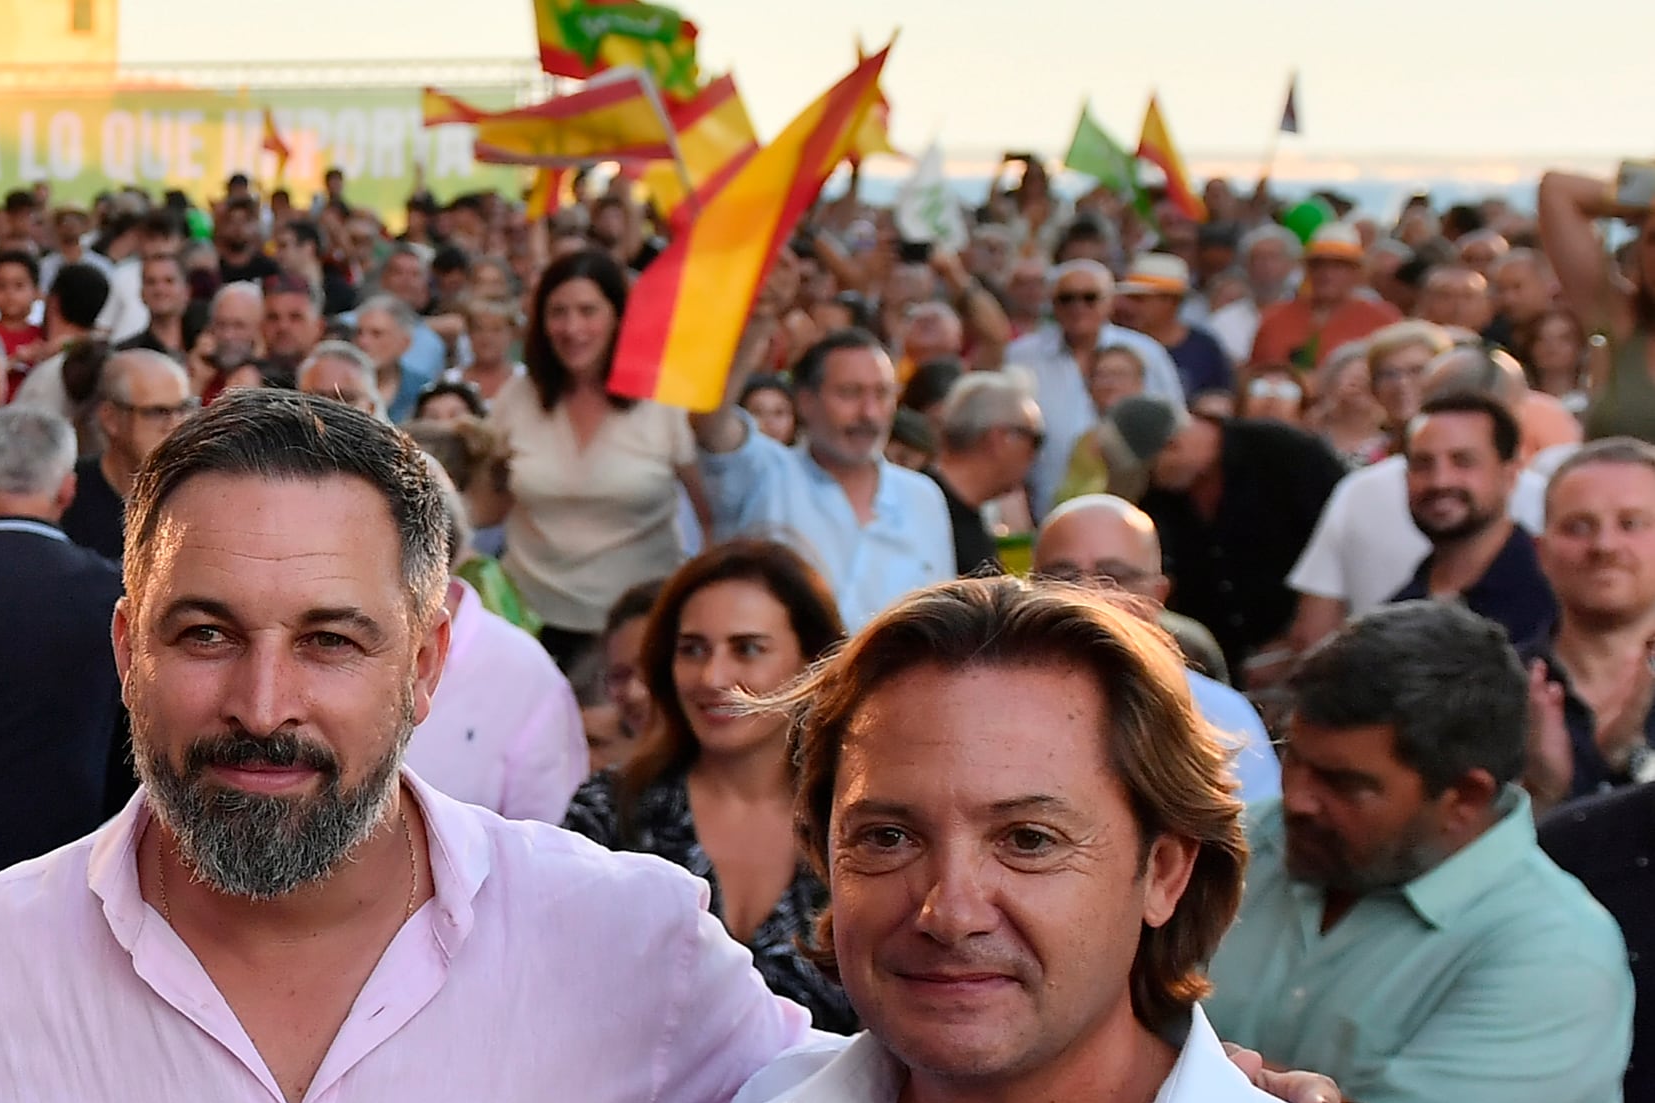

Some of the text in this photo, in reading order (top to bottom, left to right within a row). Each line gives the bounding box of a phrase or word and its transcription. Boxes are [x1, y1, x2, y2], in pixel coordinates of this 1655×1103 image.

[18, 110, 84, 181] LO
[102, 109, 204, 187] QUE
[221, 106, 475, 179] IMPORTA
